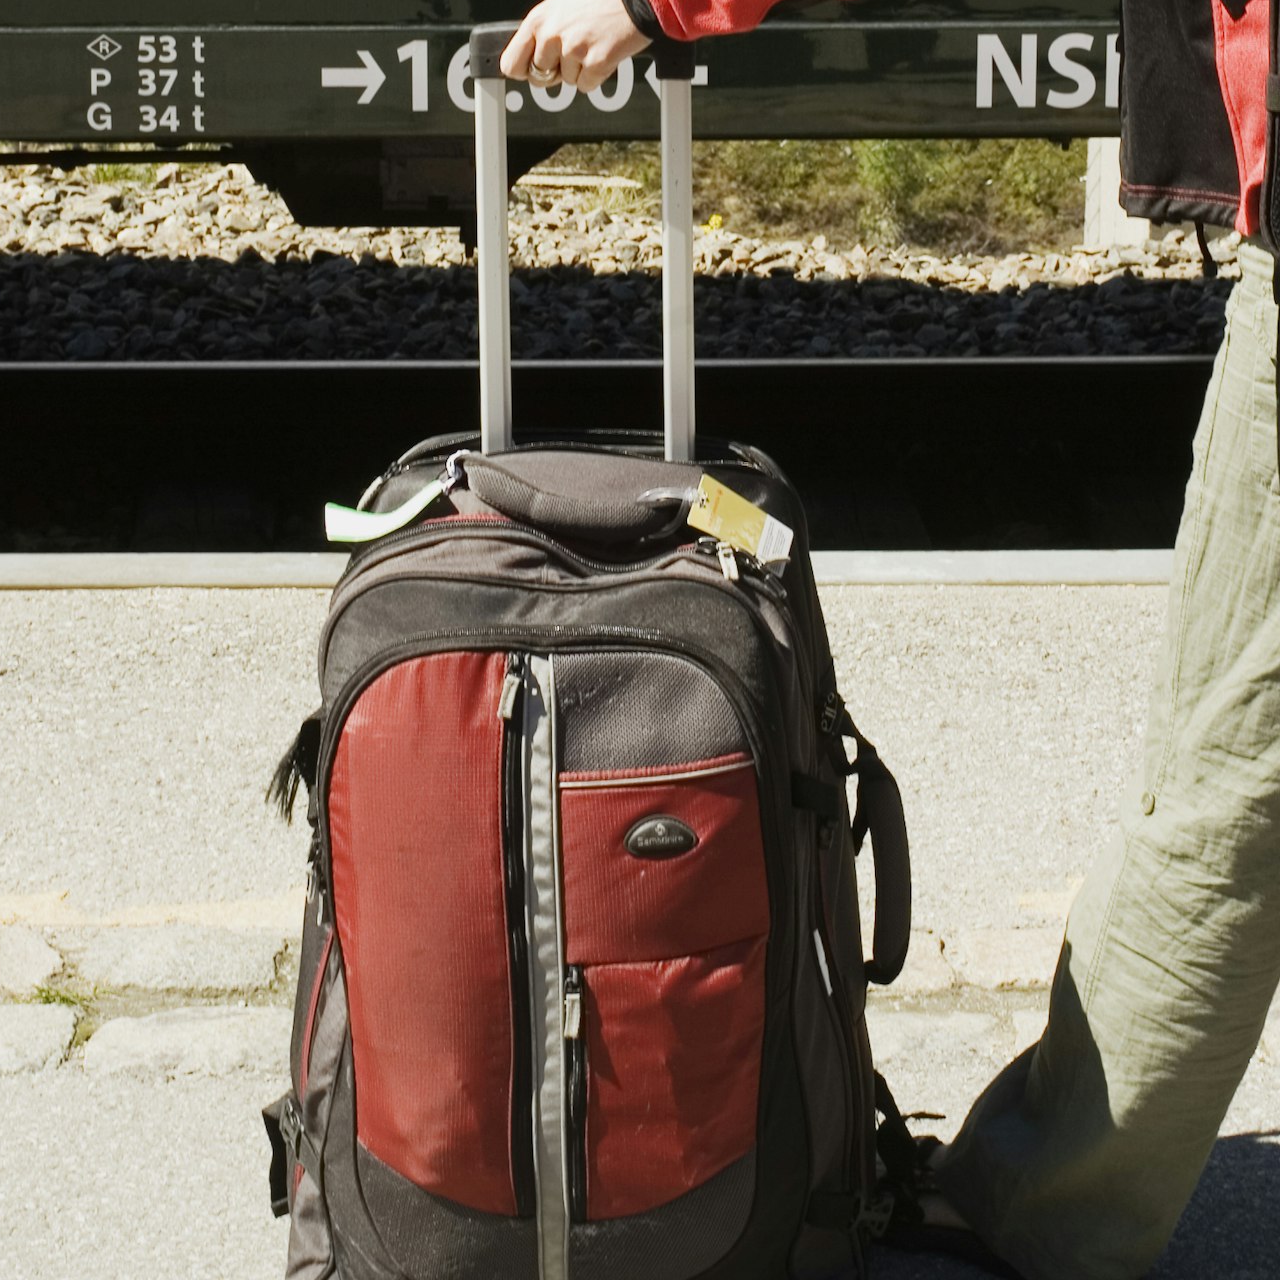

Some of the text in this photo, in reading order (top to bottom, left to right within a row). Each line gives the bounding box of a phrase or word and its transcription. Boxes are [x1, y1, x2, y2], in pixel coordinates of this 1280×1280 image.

[137, 35, 178, 64] 53
[191, 35, 205, 64] t
[90, 67, 205, 98] P 37 t
[86, 101, 205, 133] G 34 t
